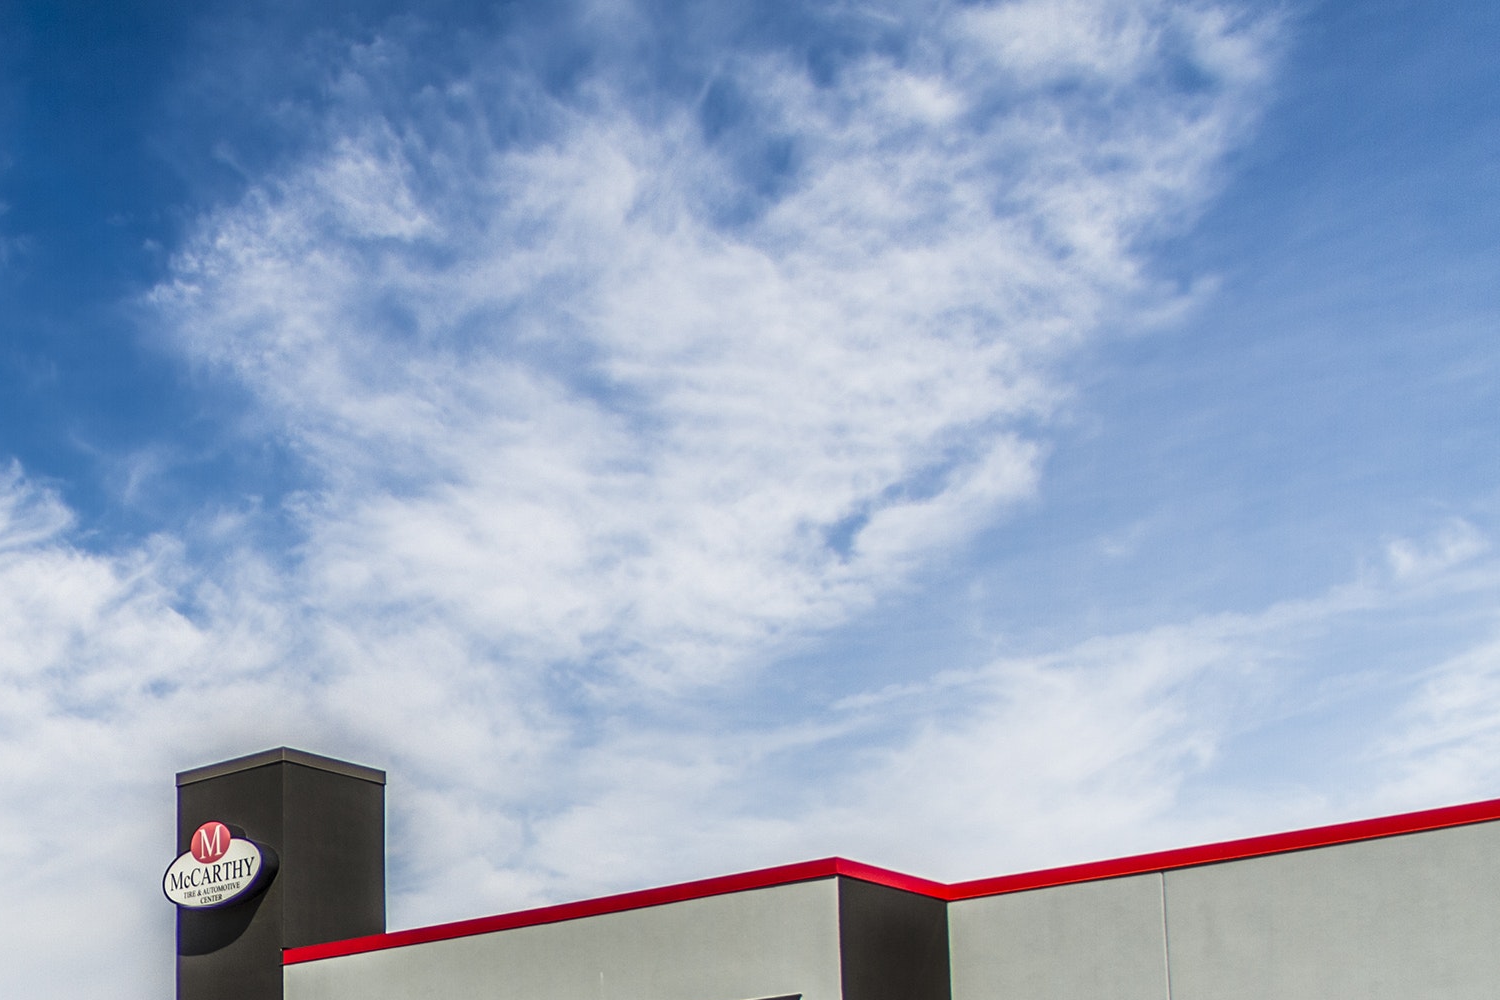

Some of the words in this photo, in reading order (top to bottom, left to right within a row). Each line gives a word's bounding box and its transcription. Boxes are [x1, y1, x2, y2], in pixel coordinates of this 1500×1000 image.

[199, 824, 223, 860] M
[170, 856, 255, 892] McCARTHY
[184, 889, 196, 900] TIRE
[197, 888, 202, 897] &
[203, 881, 241, 896] AUTOMOTIVE
[200, 893, 223, 905] CENTER
